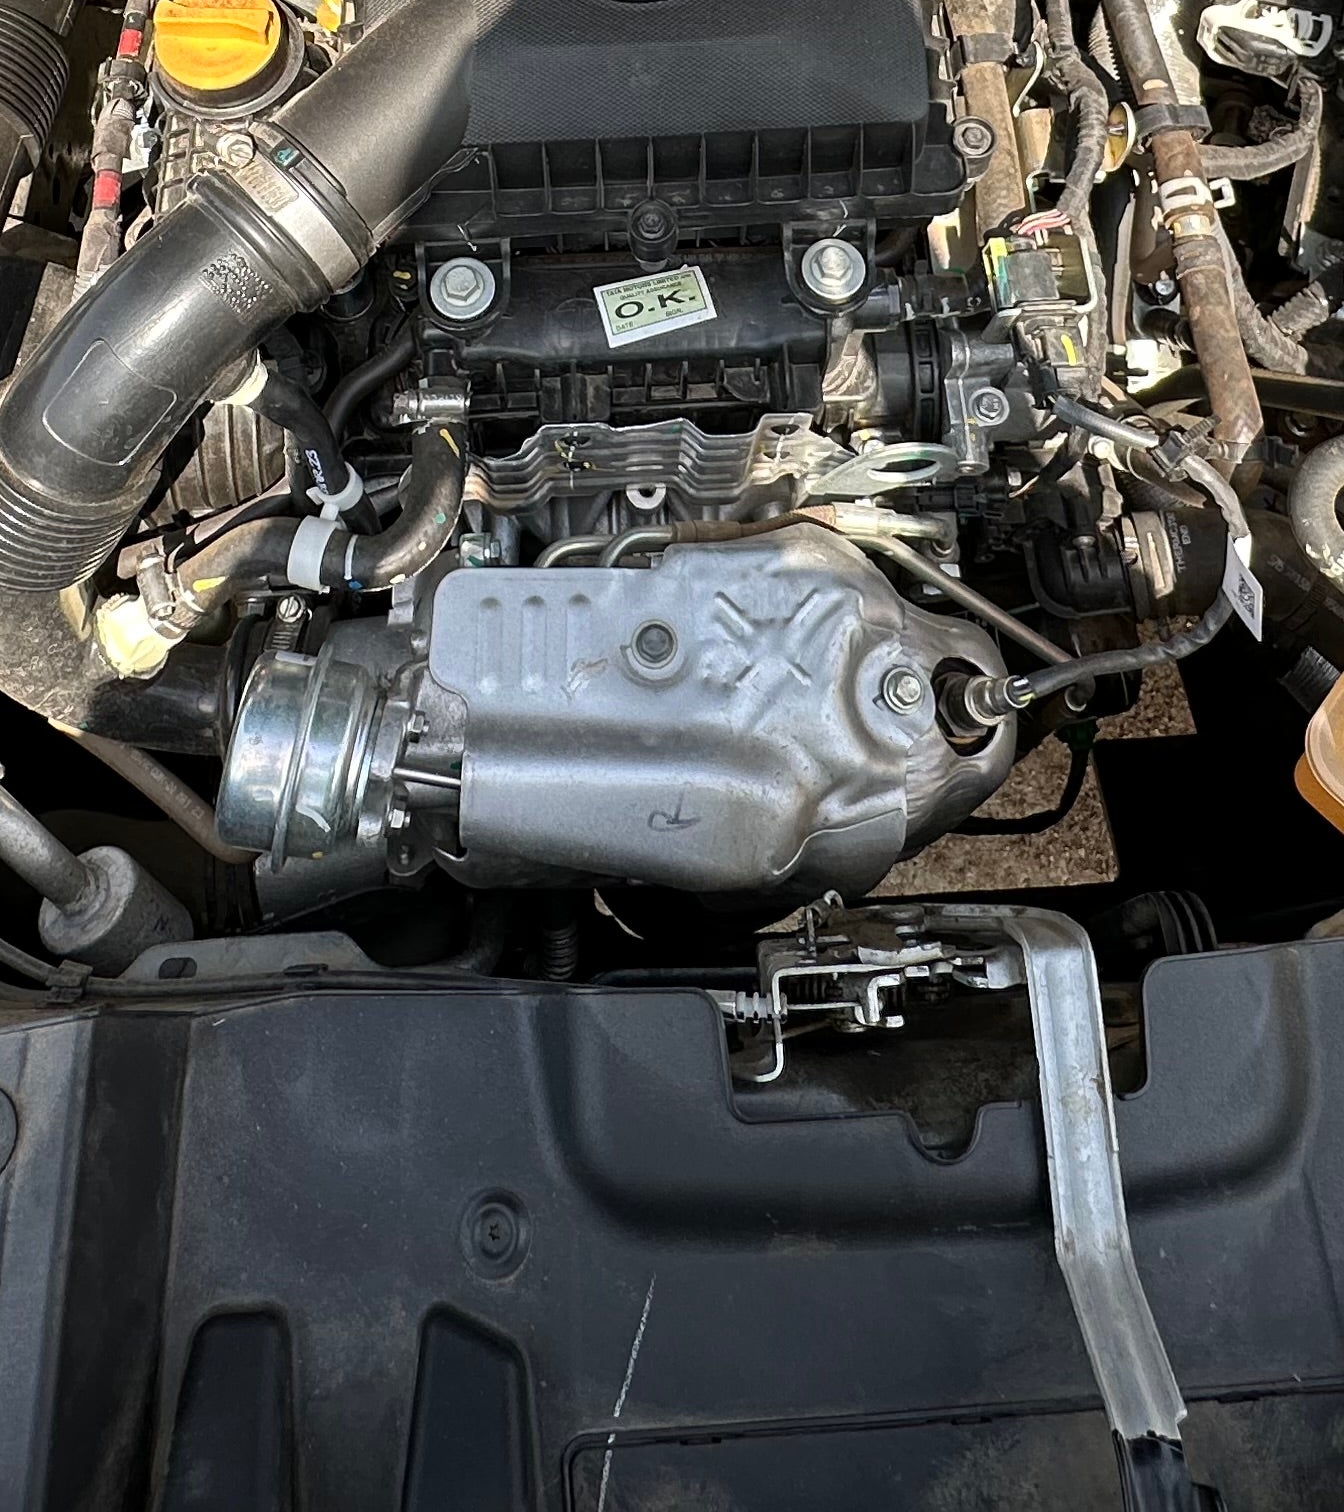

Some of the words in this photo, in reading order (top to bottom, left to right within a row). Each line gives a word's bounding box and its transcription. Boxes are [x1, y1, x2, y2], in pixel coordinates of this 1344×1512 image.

[606, 288, 623, 297] TATA
[623, 282, 652, 293] MOTORS
[653, 274, 680, 286] LIMITED
[620, 290, 645, 301] QUALITY
[616, 322, 633, 331] DATE
